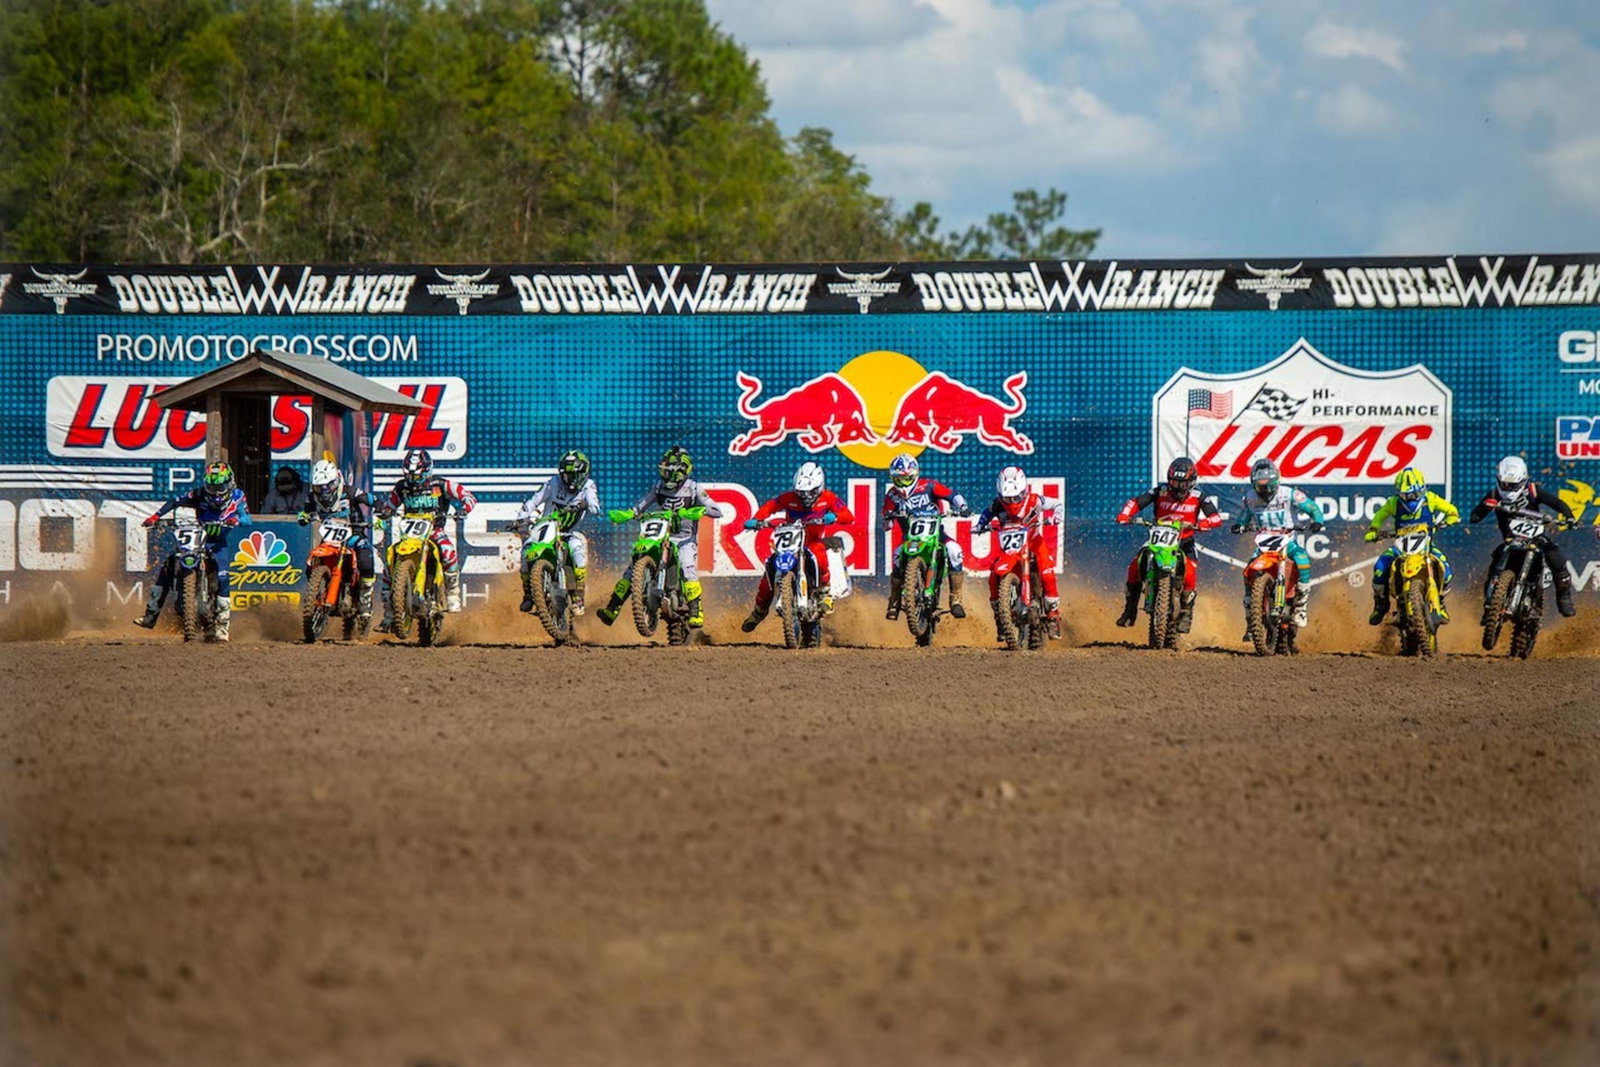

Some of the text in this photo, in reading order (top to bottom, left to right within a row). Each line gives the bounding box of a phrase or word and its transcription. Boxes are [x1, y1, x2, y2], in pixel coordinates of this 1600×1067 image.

[96, 333, 419, 361] PROMOTOCROSS.COM
[1312, 387, 1336, 400] HI-
[63, 383, 313, 451] LUCS
[1311, 404, 1440, 417] PERFORMANCE
[1193, 424, 1434, 478] LUCAS
[323, 526, 348, 541] 719
[405, 520, 428, 535] 79
[538, 527, 552, 542] 1
[645, 522, 663, 537] 9
[910, 520, 937, 536] 61
[1002, 533, 1025, 550] 23
[1151, 530, 1177, 545] 647
[1258, 535, 1285, 551] 4
[1401, 534, 1426, 552] 17
[228, 561, 303, 590] Sports
